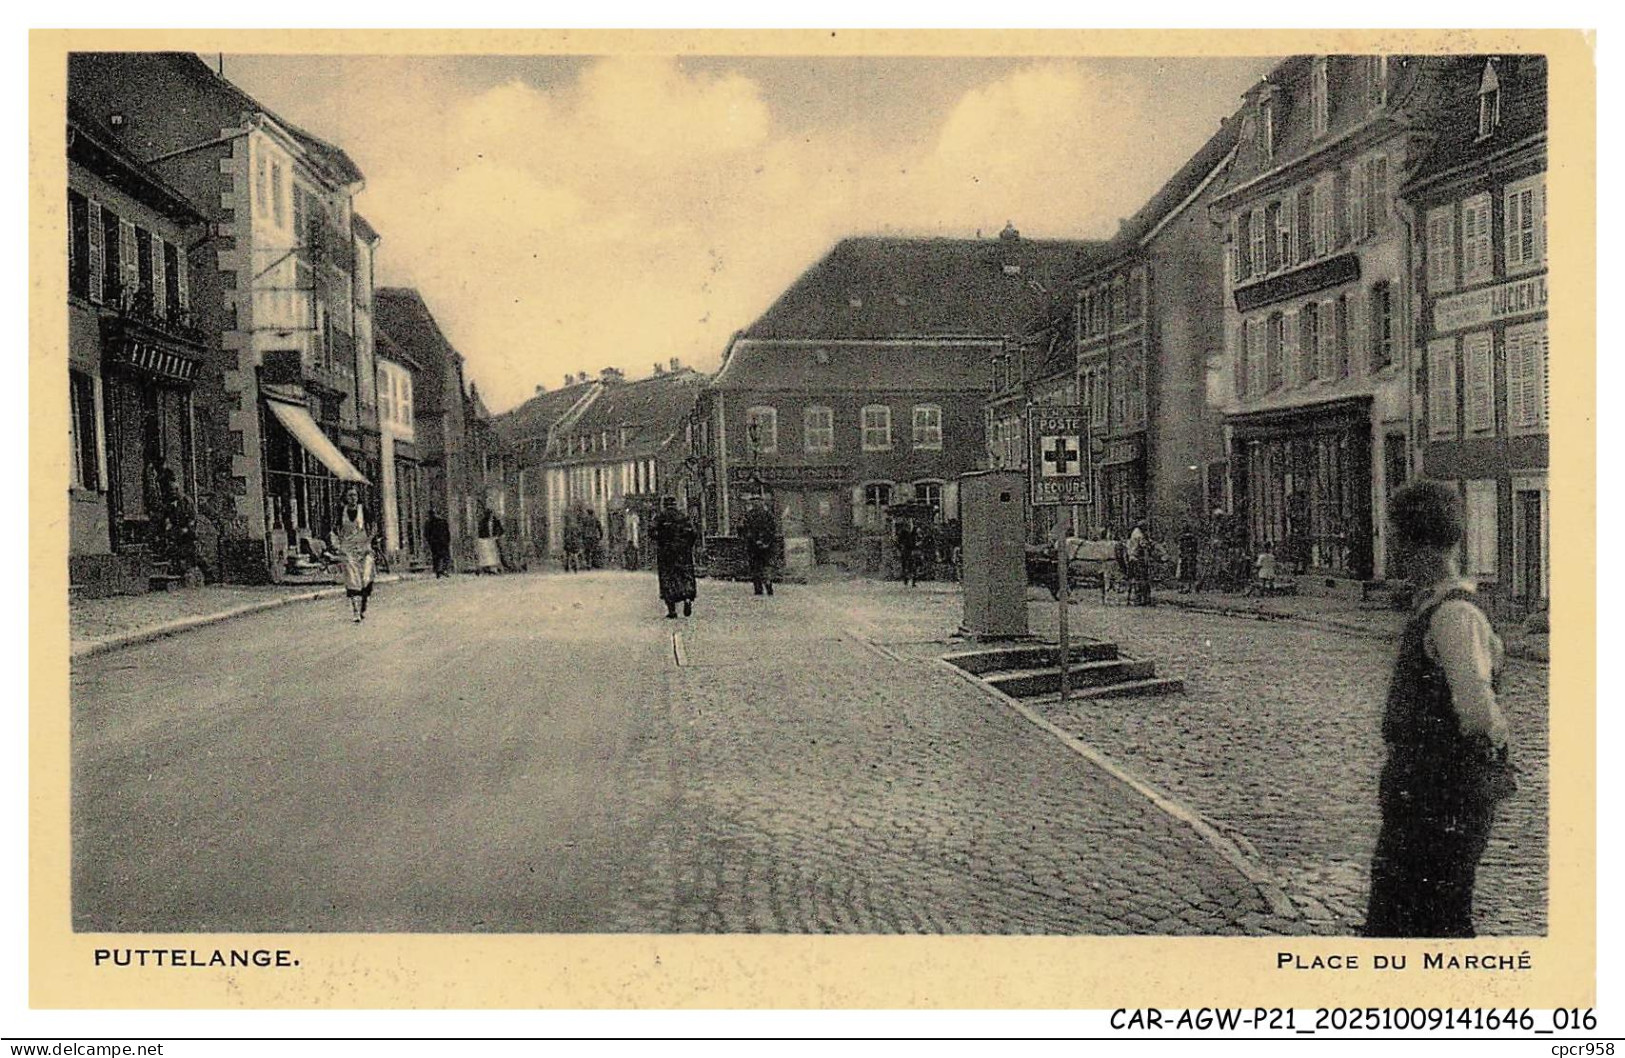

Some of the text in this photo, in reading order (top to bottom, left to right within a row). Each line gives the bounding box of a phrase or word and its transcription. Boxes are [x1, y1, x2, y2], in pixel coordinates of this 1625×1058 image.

[1491, 282, 1536, 316] LUCIEN
[1040, 419, 1080, 430] POSTE
[1037, 481, 1087, 494] SECOURS
